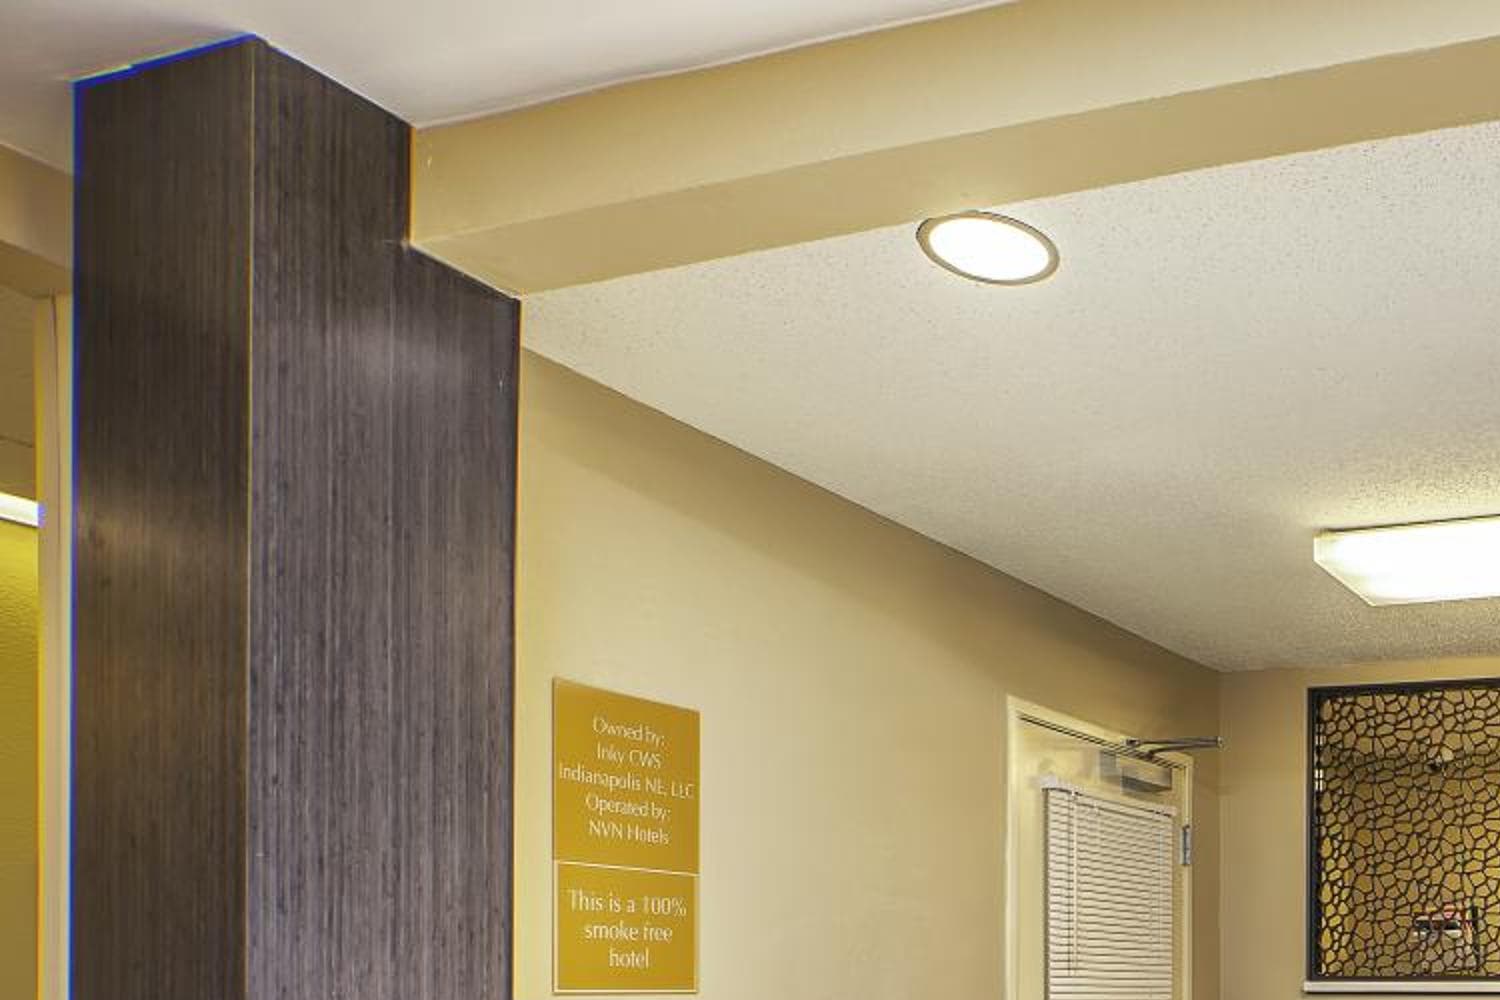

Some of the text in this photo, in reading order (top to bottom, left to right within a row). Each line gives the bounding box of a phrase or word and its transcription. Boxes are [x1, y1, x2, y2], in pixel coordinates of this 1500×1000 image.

[593, 716, 643, 741] Owned
[559, 762, 641, 791] Indianapolis
[586, 793, 649, 817] Operated
[588, 819, 669, 845] NVN Hotels
[569, 888, 688, 918] This is a 100%
[584, 920, 673, 943] smoke free
[609, 947, 650, 969] hotel
